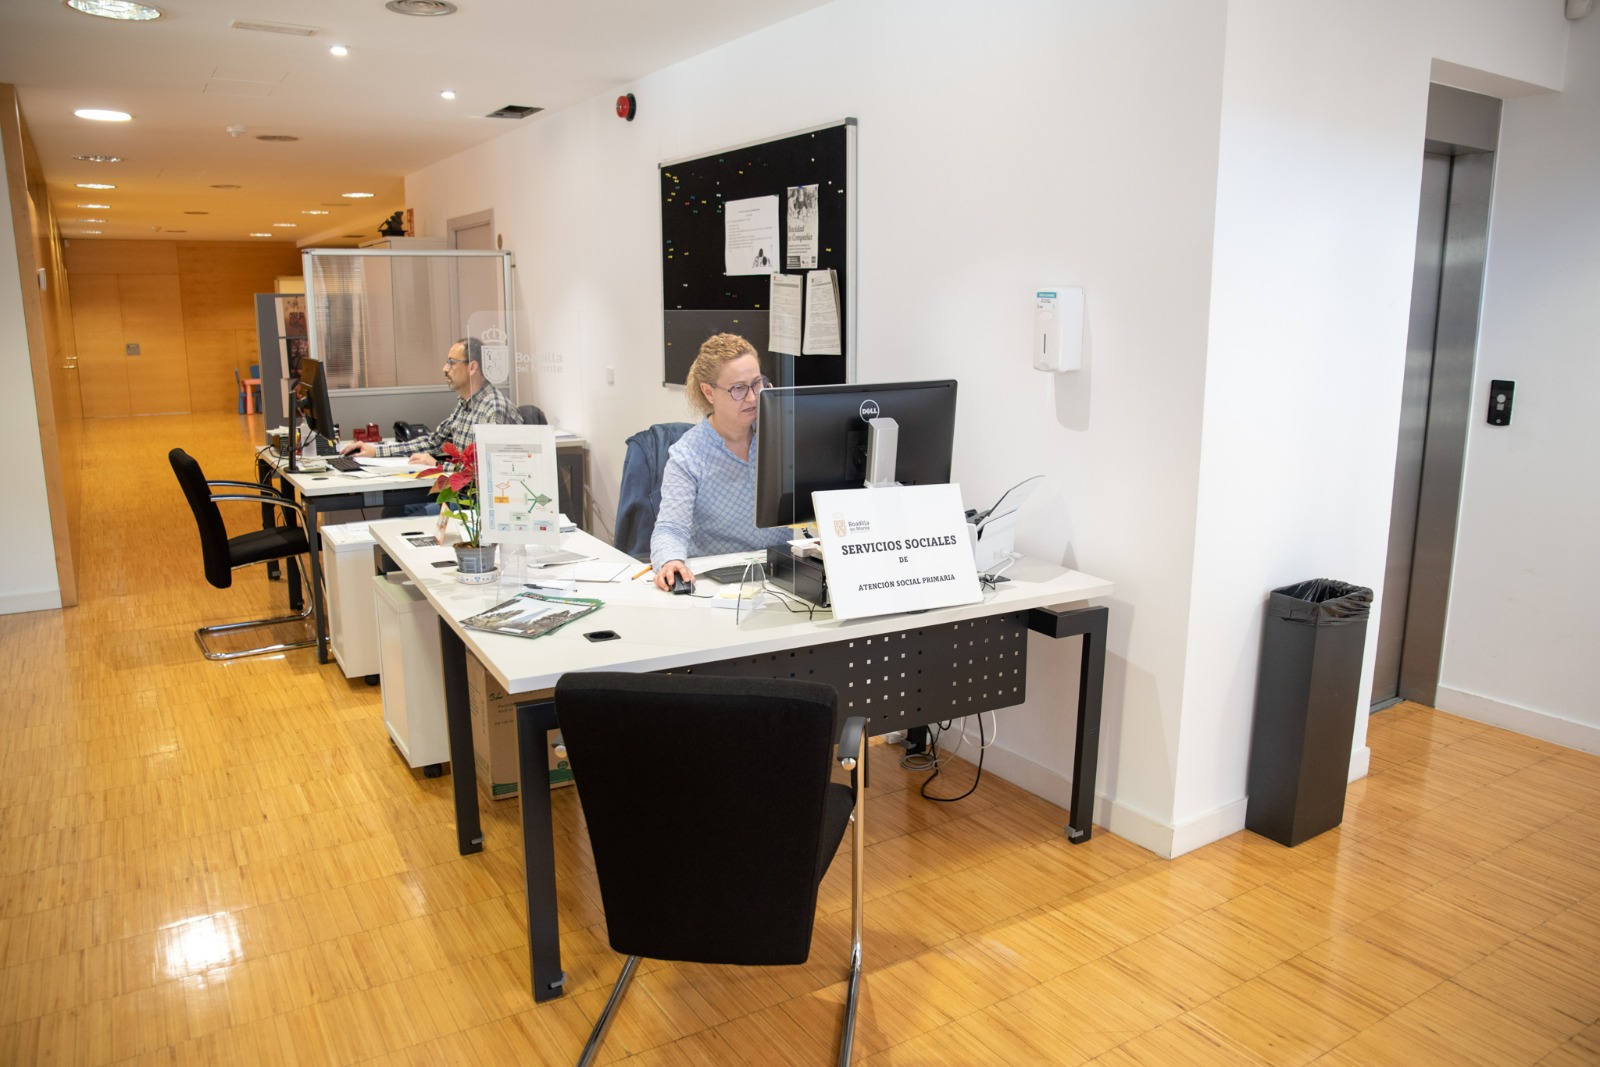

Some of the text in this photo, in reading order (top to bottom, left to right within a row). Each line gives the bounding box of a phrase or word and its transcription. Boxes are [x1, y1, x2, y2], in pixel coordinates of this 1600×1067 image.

[841, 535, 957, 556] SERVICIOS SOCIALES
[858, 574, 956, 591] ATENCIÓN SOCIAL PRIMARIA
